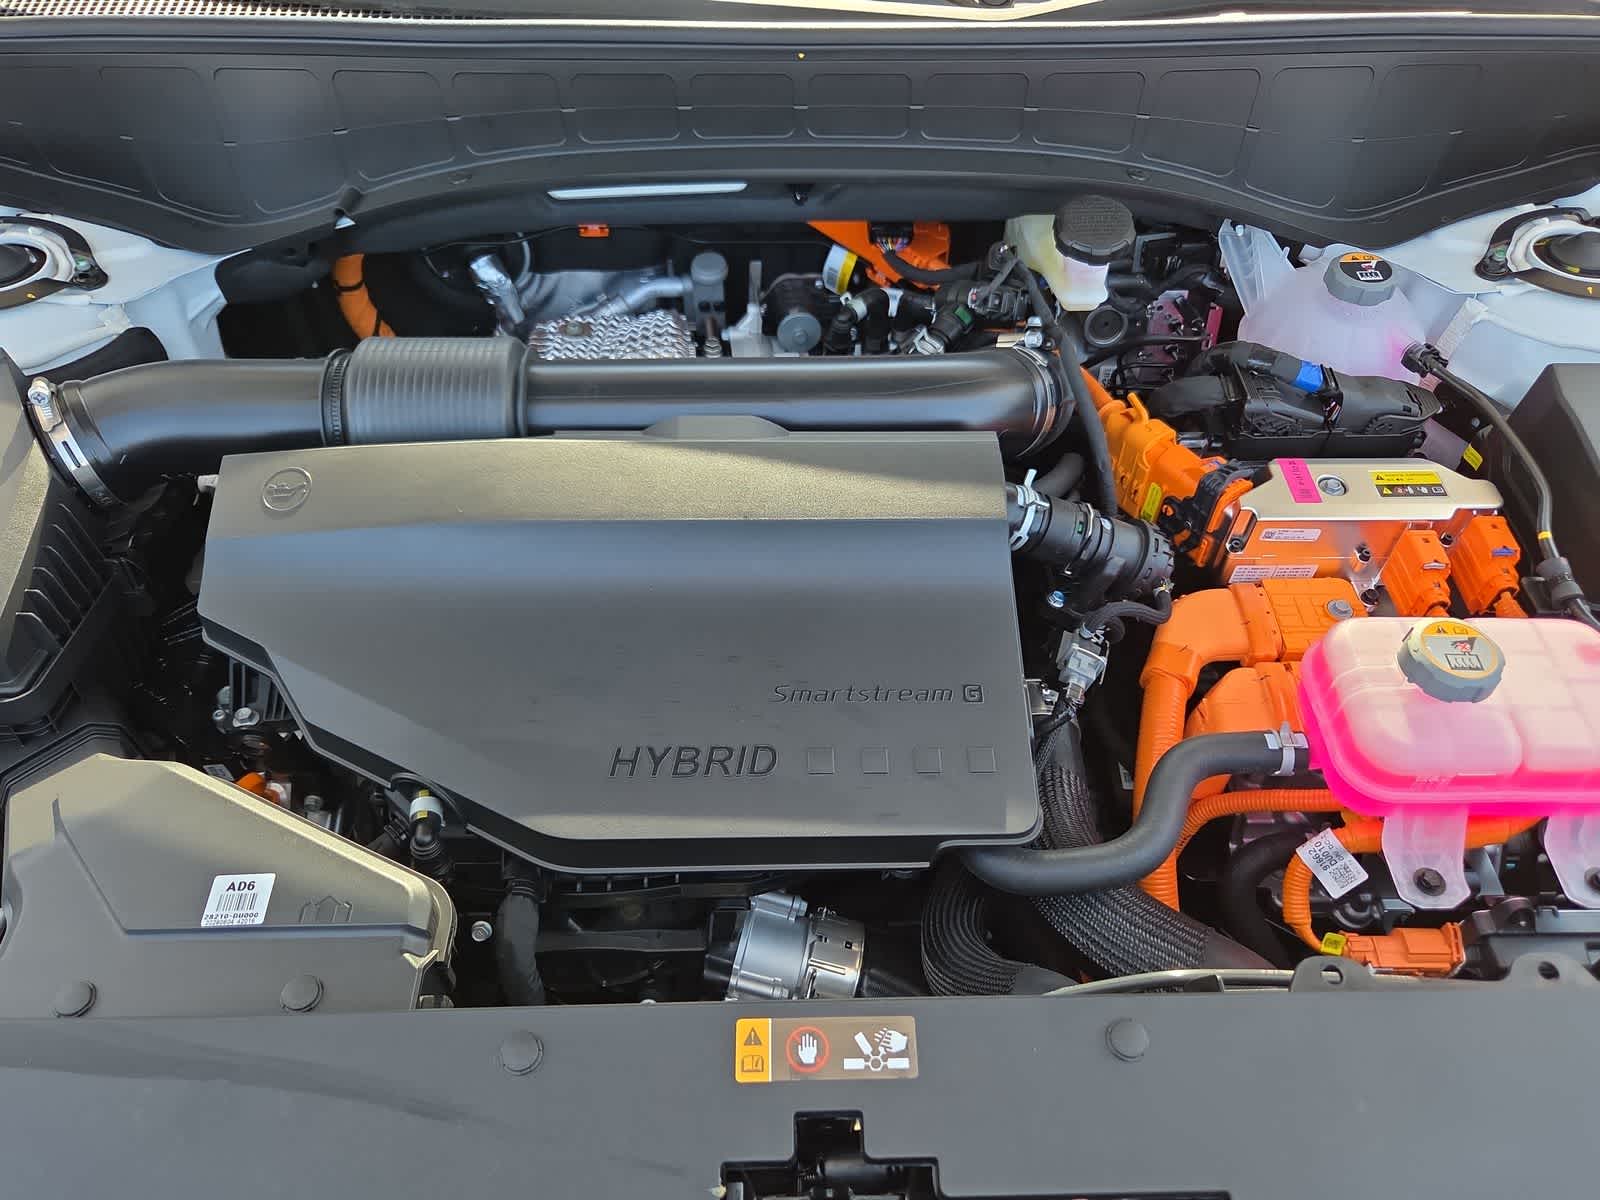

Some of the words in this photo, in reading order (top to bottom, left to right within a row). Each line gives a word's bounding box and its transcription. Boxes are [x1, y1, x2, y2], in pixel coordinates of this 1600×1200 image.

[773, 684, 954, 704] Smartstream
[963, 684, 985, 703] G
[607, 744, 780, 778] HYBRID
[226, 880, 256, 892] AD6
